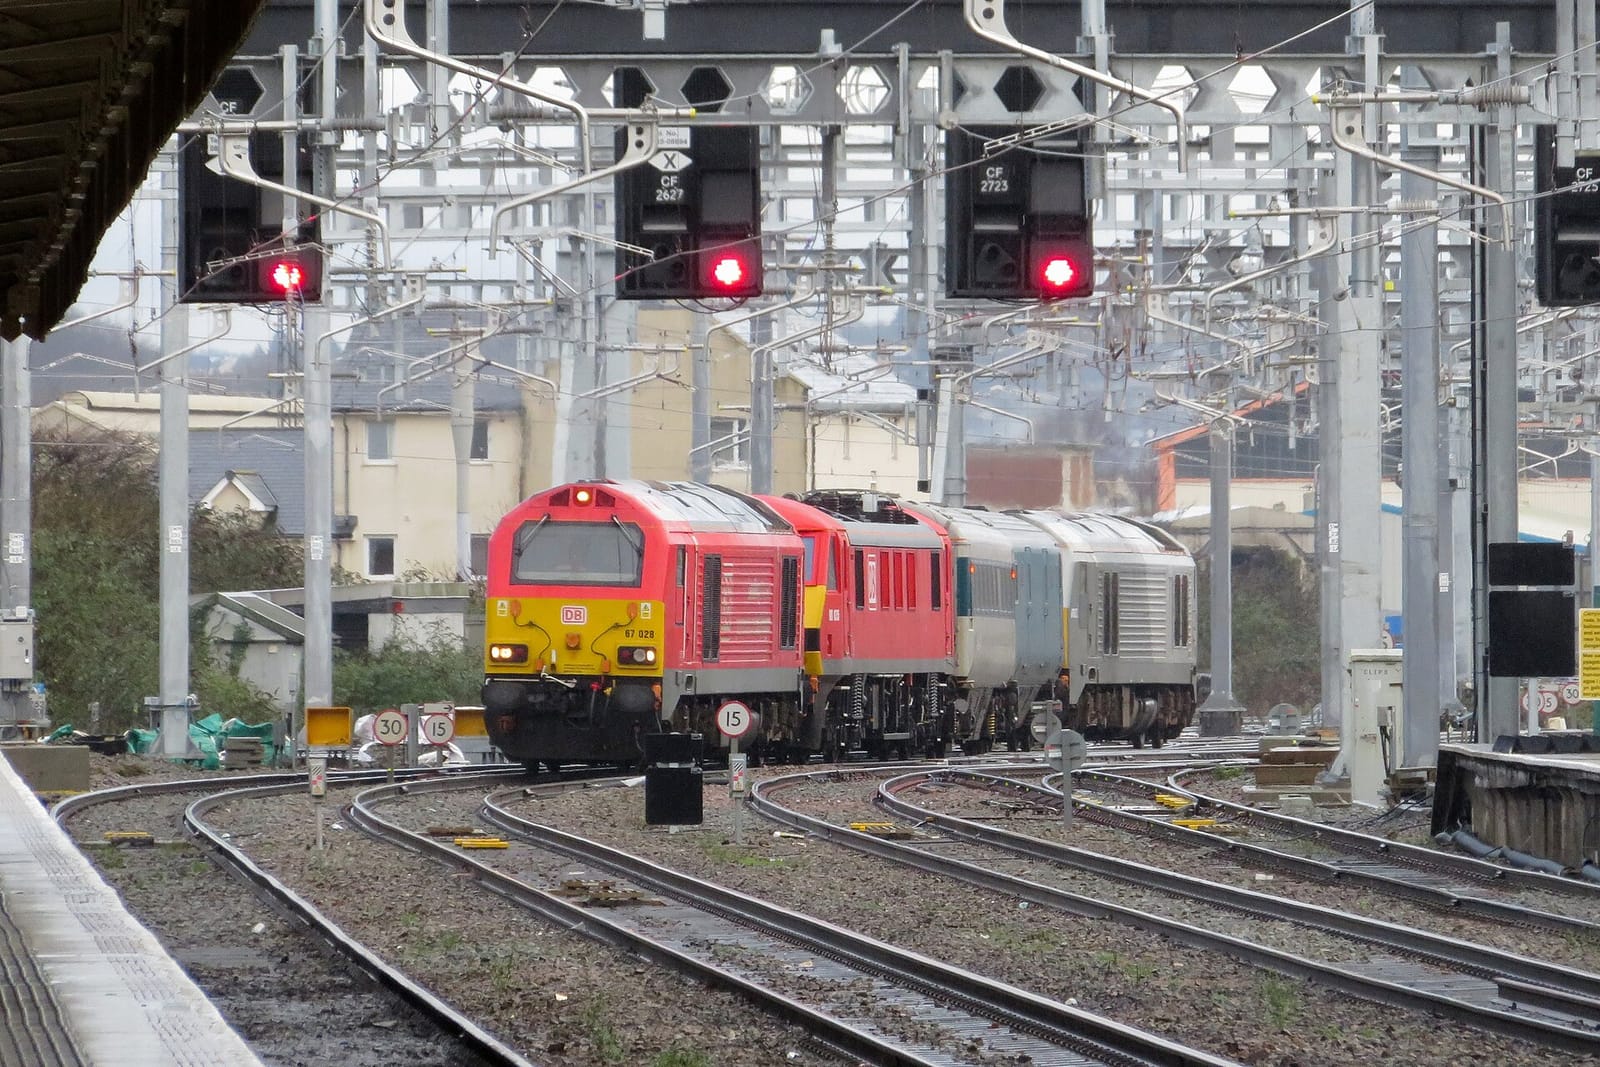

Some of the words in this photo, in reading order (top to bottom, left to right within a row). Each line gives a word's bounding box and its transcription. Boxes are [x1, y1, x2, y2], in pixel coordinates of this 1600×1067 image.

[220, 101, 237, 113] CF
[663, 153, 676, 169] X
[986, 167, 1003, 178] CF
[1576, 167, 1593, 179] CF
[661, 175, 678, 187] CF
[981, 180, 1009, 192] 2723
[656, 189, 684, 201] 2627
[565, 609, 582, 621] DB
[625, 629, 635, 638] 67
[639, 630, 655, 639] 028
[1566, 688, 1579, 699] 30
[726, 711, 741, 727] 15
[380, 719, 401, 735] 30
[432, 722, 446, 736] 15
